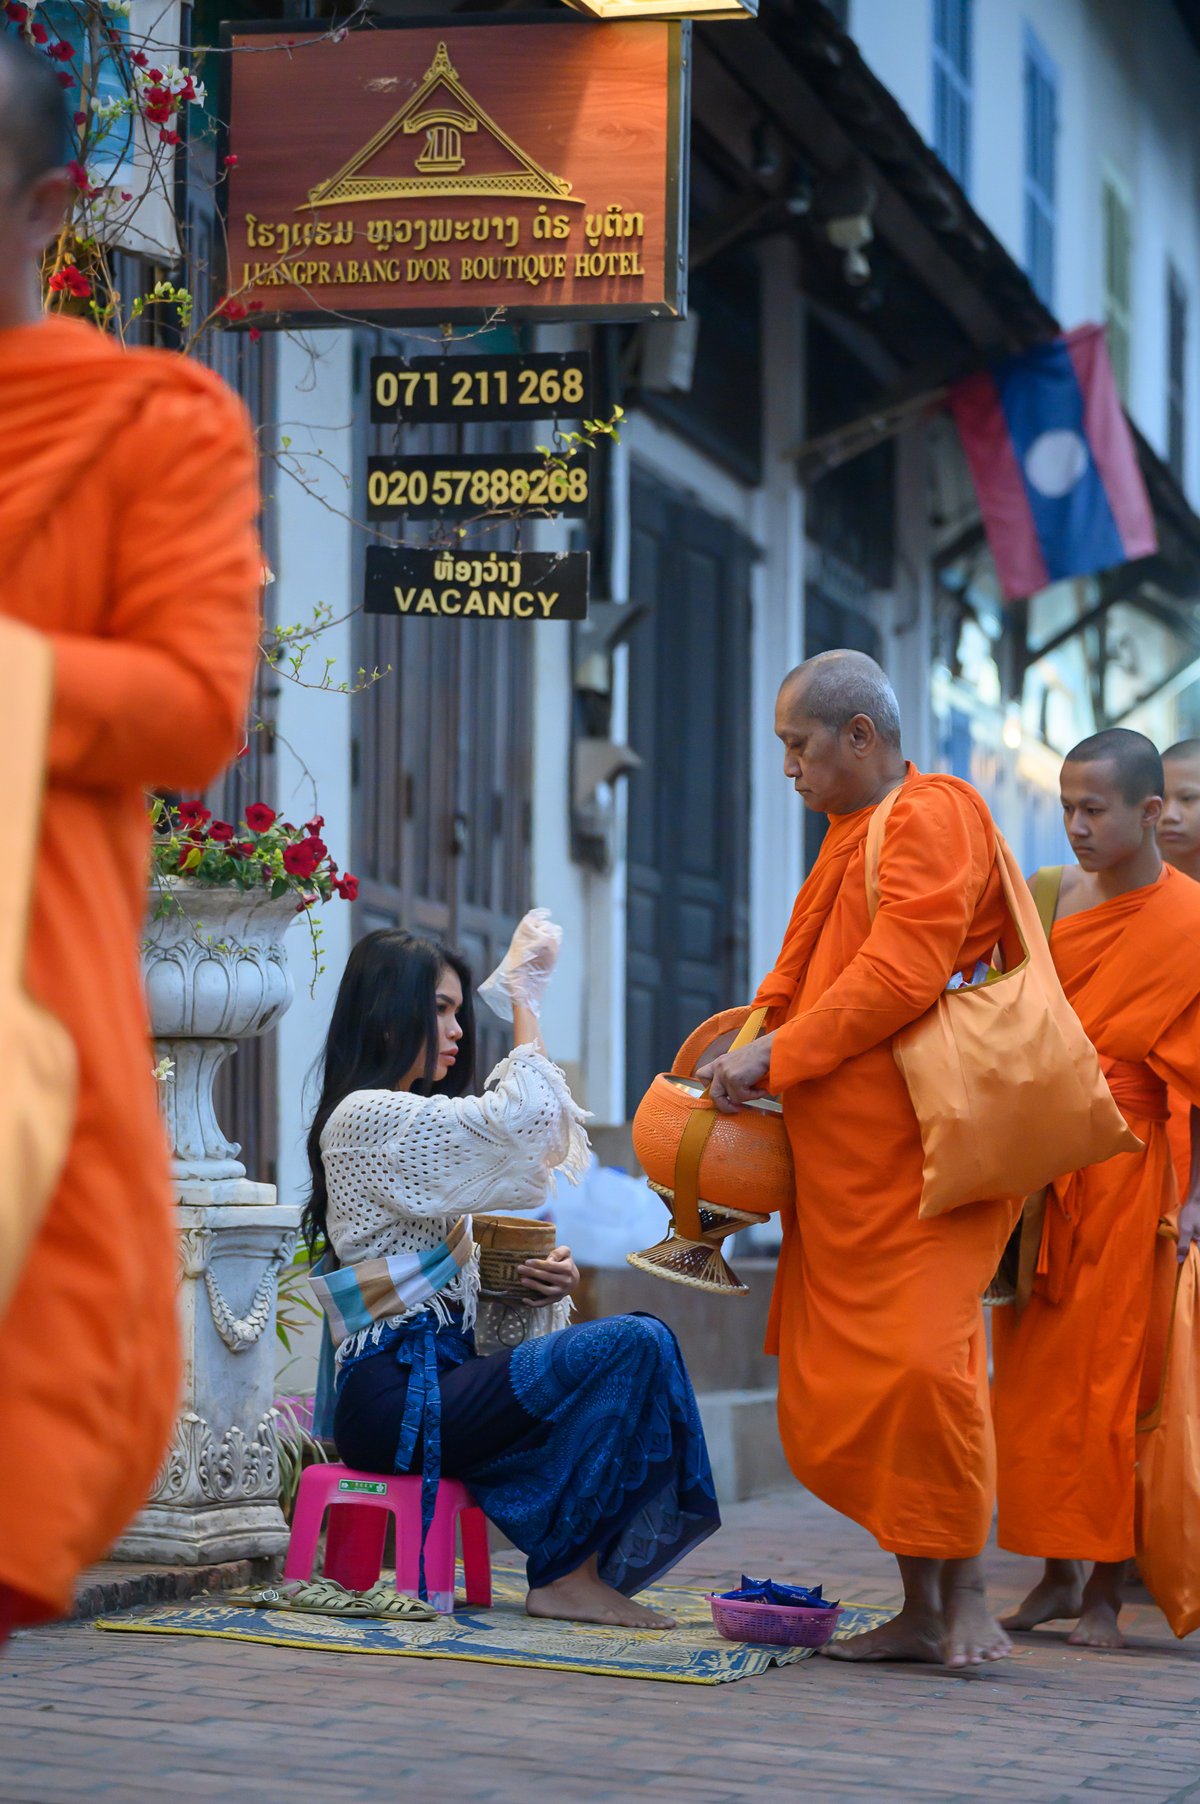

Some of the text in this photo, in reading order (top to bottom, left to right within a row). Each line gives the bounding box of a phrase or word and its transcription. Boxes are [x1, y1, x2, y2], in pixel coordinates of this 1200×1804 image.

[243, 251, 645, 288] LUANGPRABANG D'OR BOUTIQUE HOTEL
[376, 368, 584, 406] 071 211 268
[368, 468, 588, 506] 020 57888268
[394, 585, 559, 617] VACANCY
